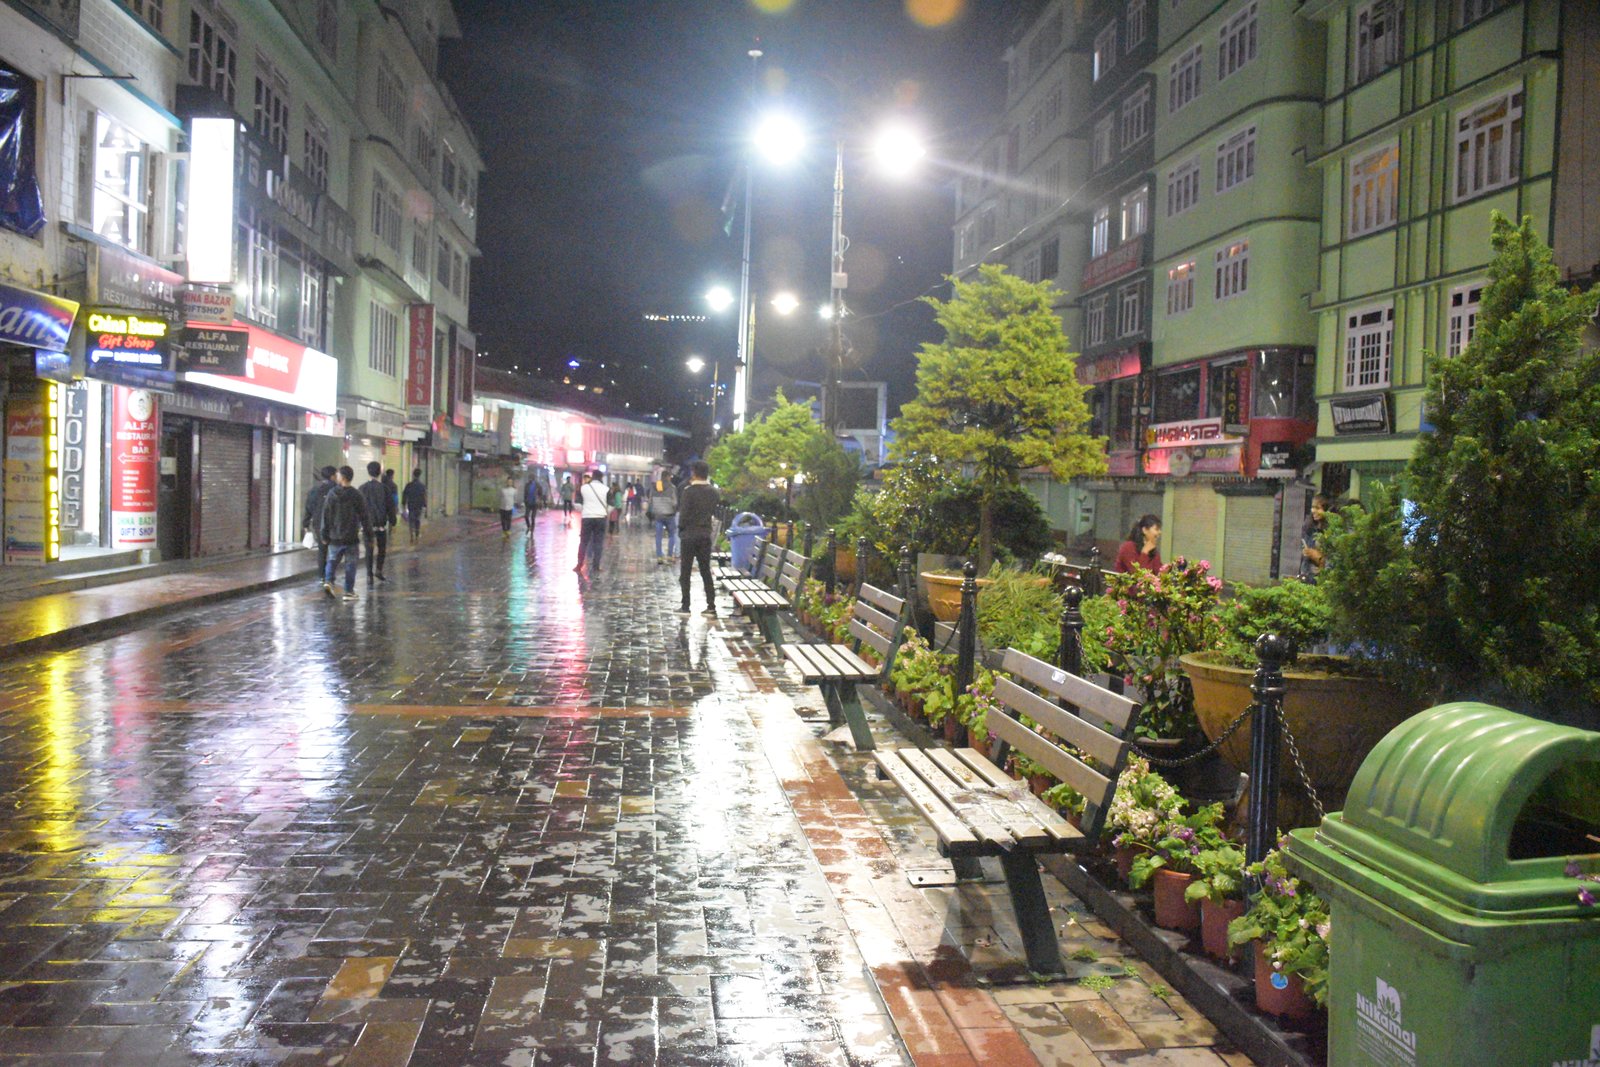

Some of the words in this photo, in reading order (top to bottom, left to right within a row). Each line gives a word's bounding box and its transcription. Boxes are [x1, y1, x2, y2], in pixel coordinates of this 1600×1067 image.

[204, 294, 232, 306] BAZAR
[88, 313, 127, 336] China
[197, 331, 228, 342] ALFA
[98, 334, 122, 349] Gift
[123, 336, 156, 351] Shop
[184, 341, 240, 352] RESTAURANT
[200, 356, 220, 365] BAR
[123, 421, 155, 431] ALFA
[132, 446, 150, 454] BAR
[63, 391, 83, 527] LODGE
[138, 527, 154, 537] SHOP
[1356, 992, 1417, 1051] Nilkamal
